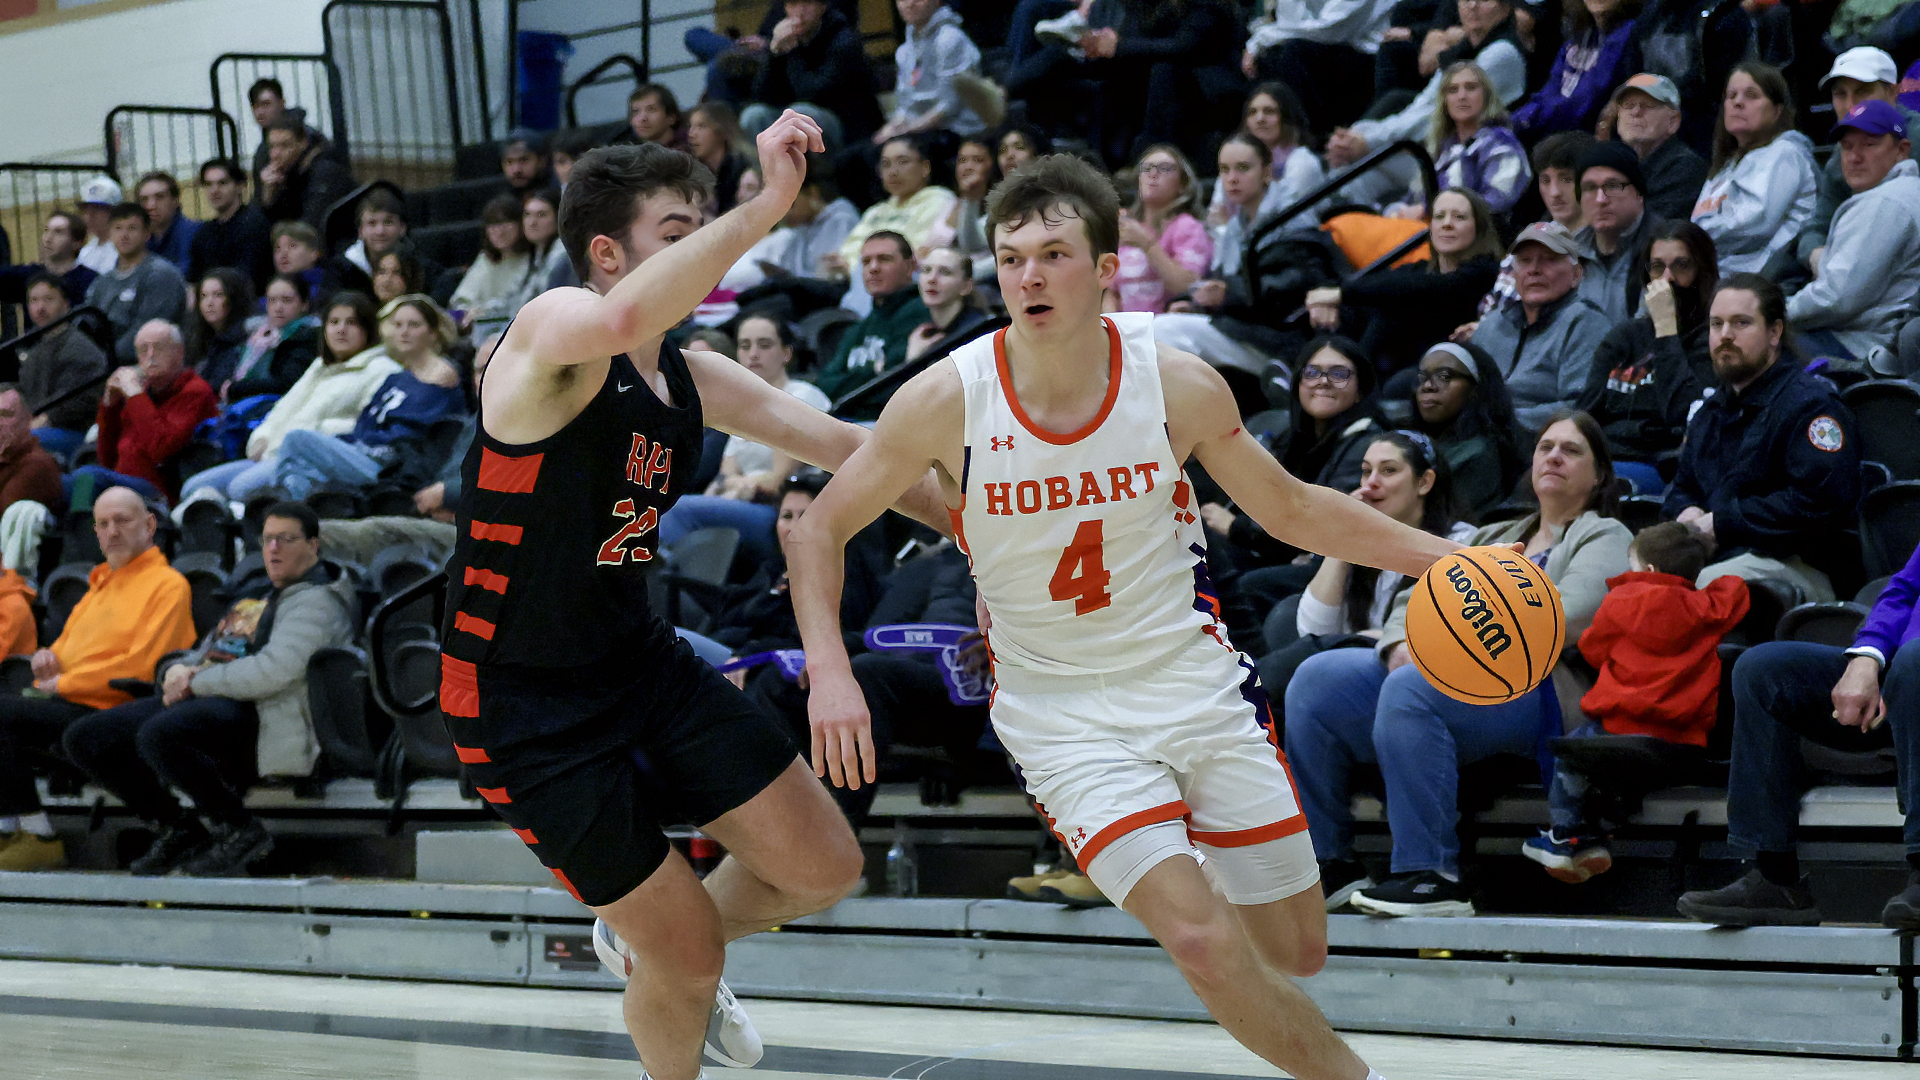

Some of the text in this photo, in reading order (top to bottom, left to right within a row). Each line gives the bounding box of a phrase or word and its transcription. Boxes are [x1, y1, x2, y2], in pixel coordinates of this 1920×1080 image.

[626, 432, 673, 494] RPI
[984, 461, 1160, 516] HOBART
[1048, 519, 1111, 616] 4
[1446, 563, 1512, 661] Wilson
